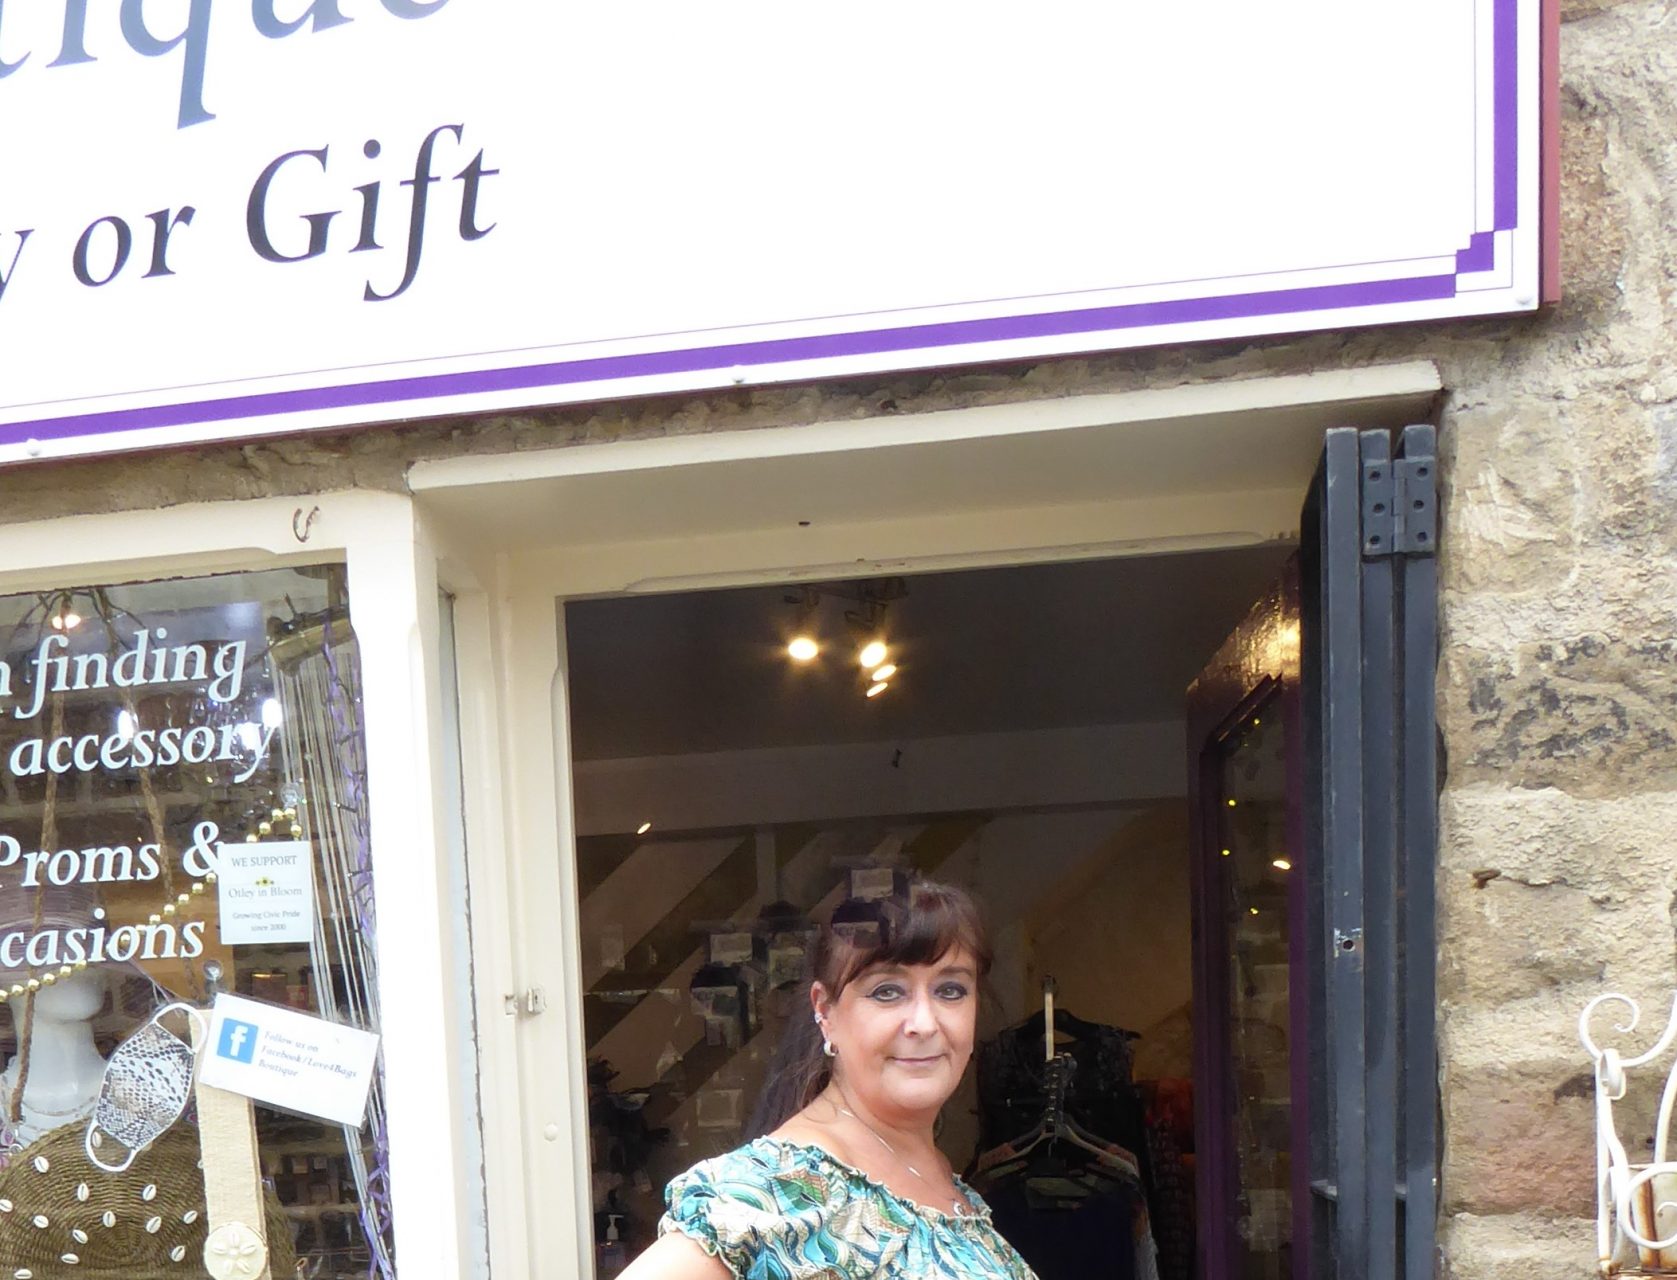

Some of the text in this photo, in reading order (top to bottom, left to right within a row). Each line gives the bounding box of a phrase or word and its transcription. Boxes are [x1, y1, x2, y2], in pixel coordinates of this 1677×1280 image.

[72, 205, 197, 288] or
[245, 123, 500, 302] Gift
[15, 627, 247, 719] finding
[9, 722, 277, 784] accessory
[182, 820, 224, 878] &
[231, 855, 297, 868] WE SUPPORT
[258, 886, 267, 897] in
[270, 886, 302, 897] Bloom
[264, 1031, 319, 1053] Follow us on
[258, 1058, 299, 1077] Boutique
